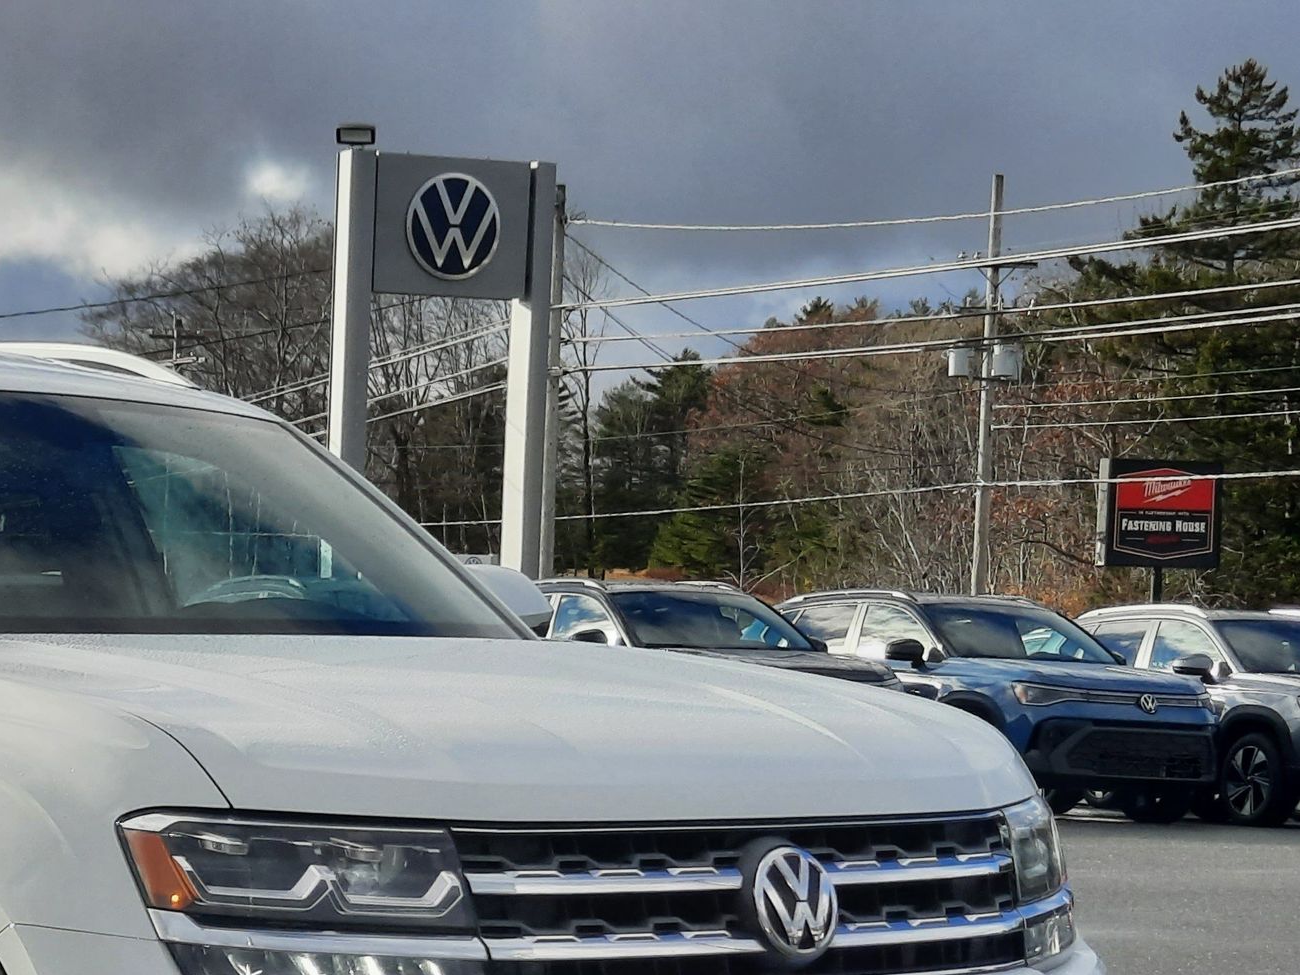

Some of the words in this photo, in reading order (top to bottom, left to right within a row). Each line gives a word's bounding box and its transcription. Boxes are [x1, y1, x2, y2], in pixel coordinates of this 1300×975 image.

[410, 175, 498, 276] VW
[1120, 518, 1172, 532] FASTENING
[1175, 520, 1206, 533] HOUSE
[757, 849, 833, 950] VW
